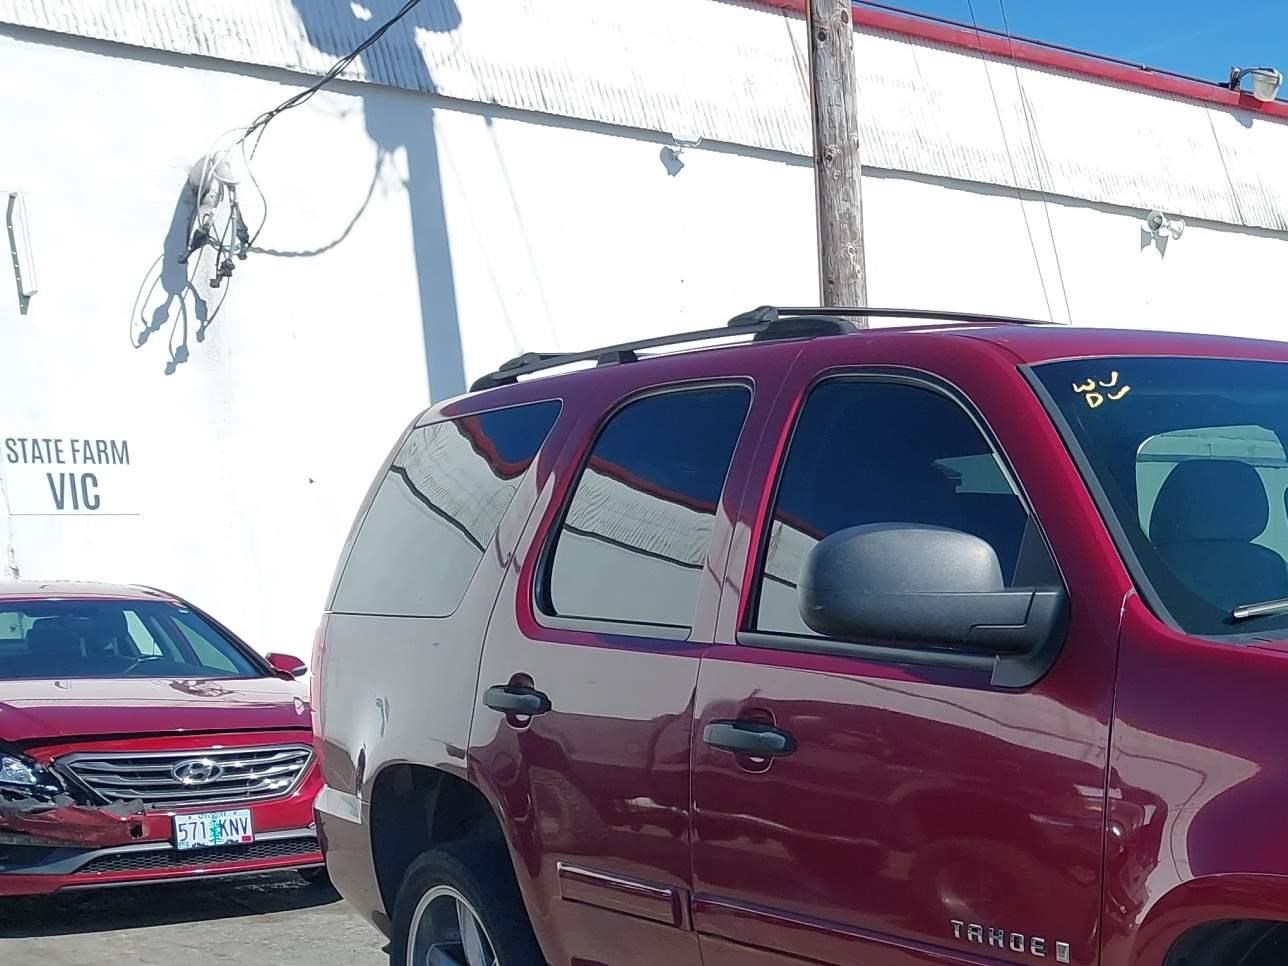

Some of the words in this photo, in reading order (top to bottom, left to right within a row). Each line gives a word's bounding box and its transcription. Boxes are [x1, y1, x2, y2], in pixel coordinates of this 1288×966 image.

[5, 437, 66, 464] STATE
[70, 438, 130, 465] FARM
[46, 472, 101, 511] VIC
[950, 919, 1047, 958] TAHOE
